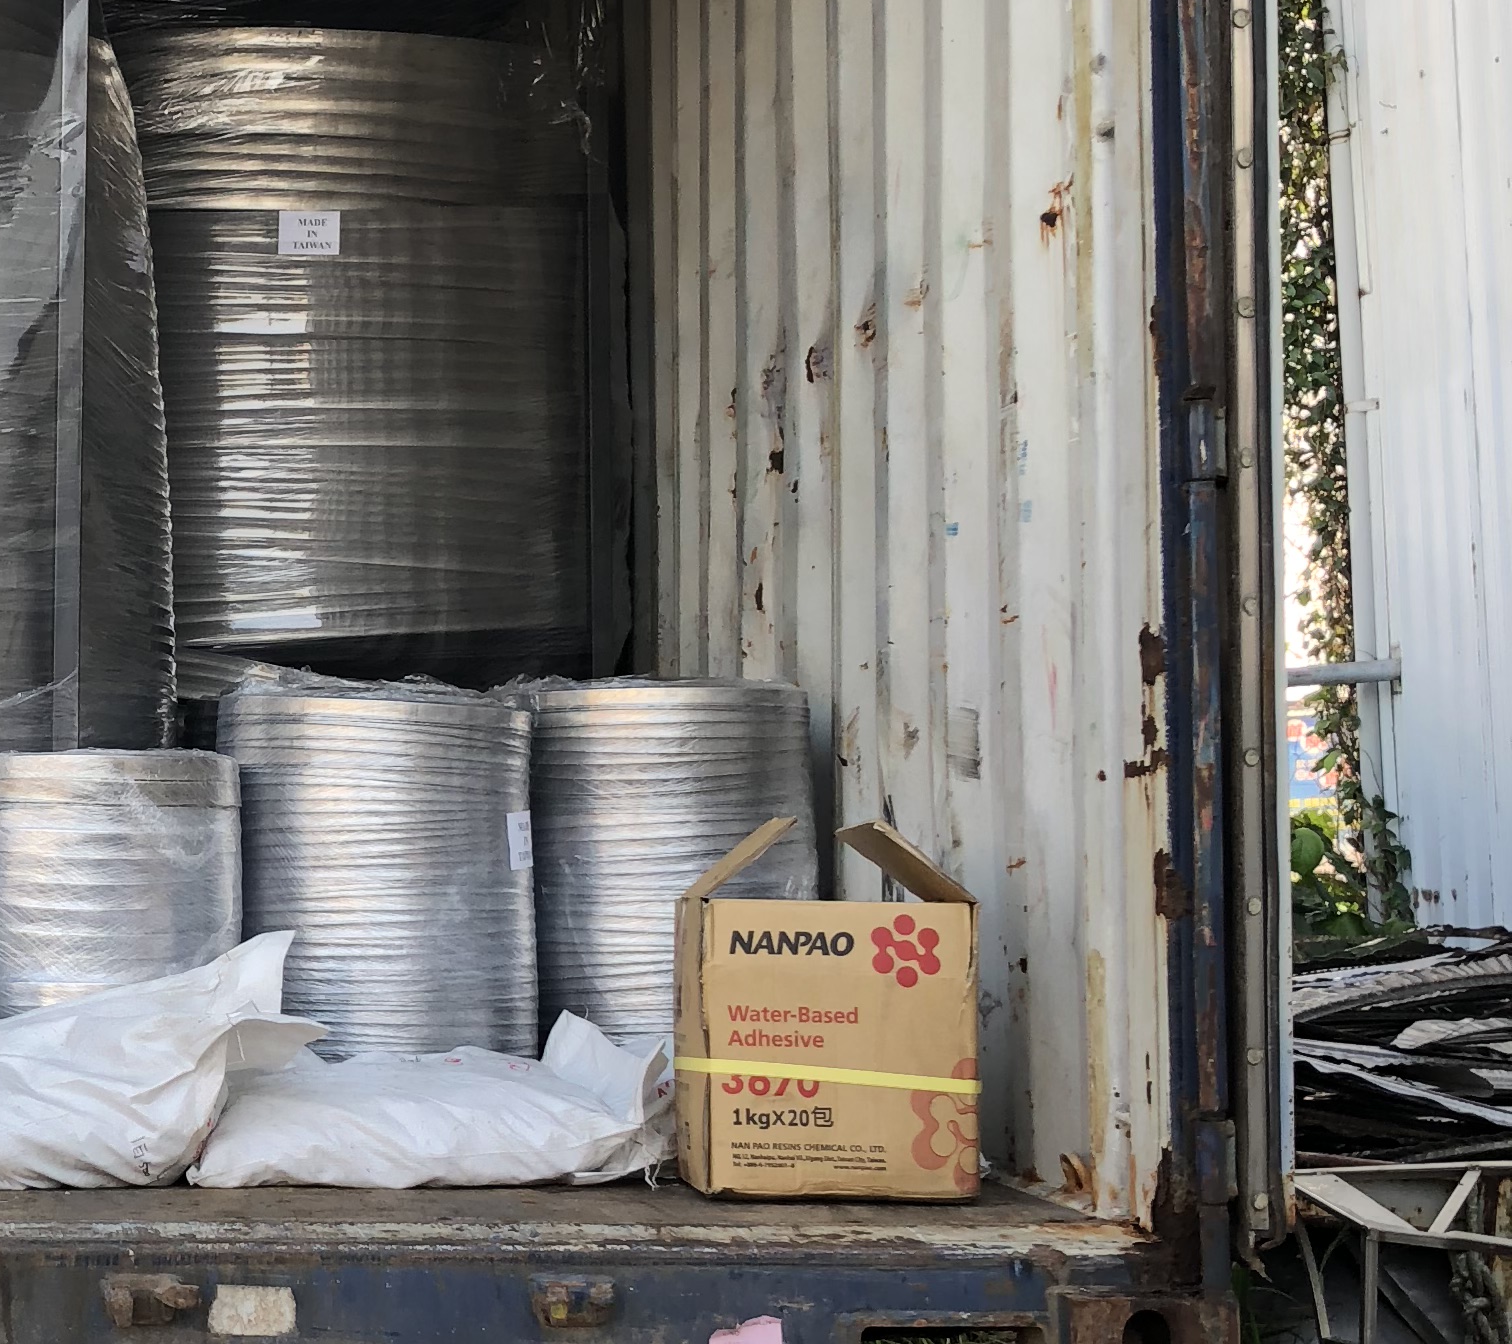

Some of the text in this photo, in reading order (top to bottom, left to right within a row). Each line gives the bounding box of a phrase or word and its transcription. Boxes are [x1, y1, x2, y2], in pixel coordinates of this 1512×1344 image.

[298, 218, 328, 227] MADE
[307, 229, 318, 238] IN
[293, 241, 333, 250] TAIWAN
[729, 930, 855, 957] NANPAO
[727, 1004, 859, 1025] Water-Based
[727, 1028, 825, 1049] Adhesive
[731, 1141, 751, 1150] NAN
[752, 1142, 771, 1150] PAO
[772, 1142, 802, 1151] RESINS
[803, 1143, 848, 1152] CHEMICAL
